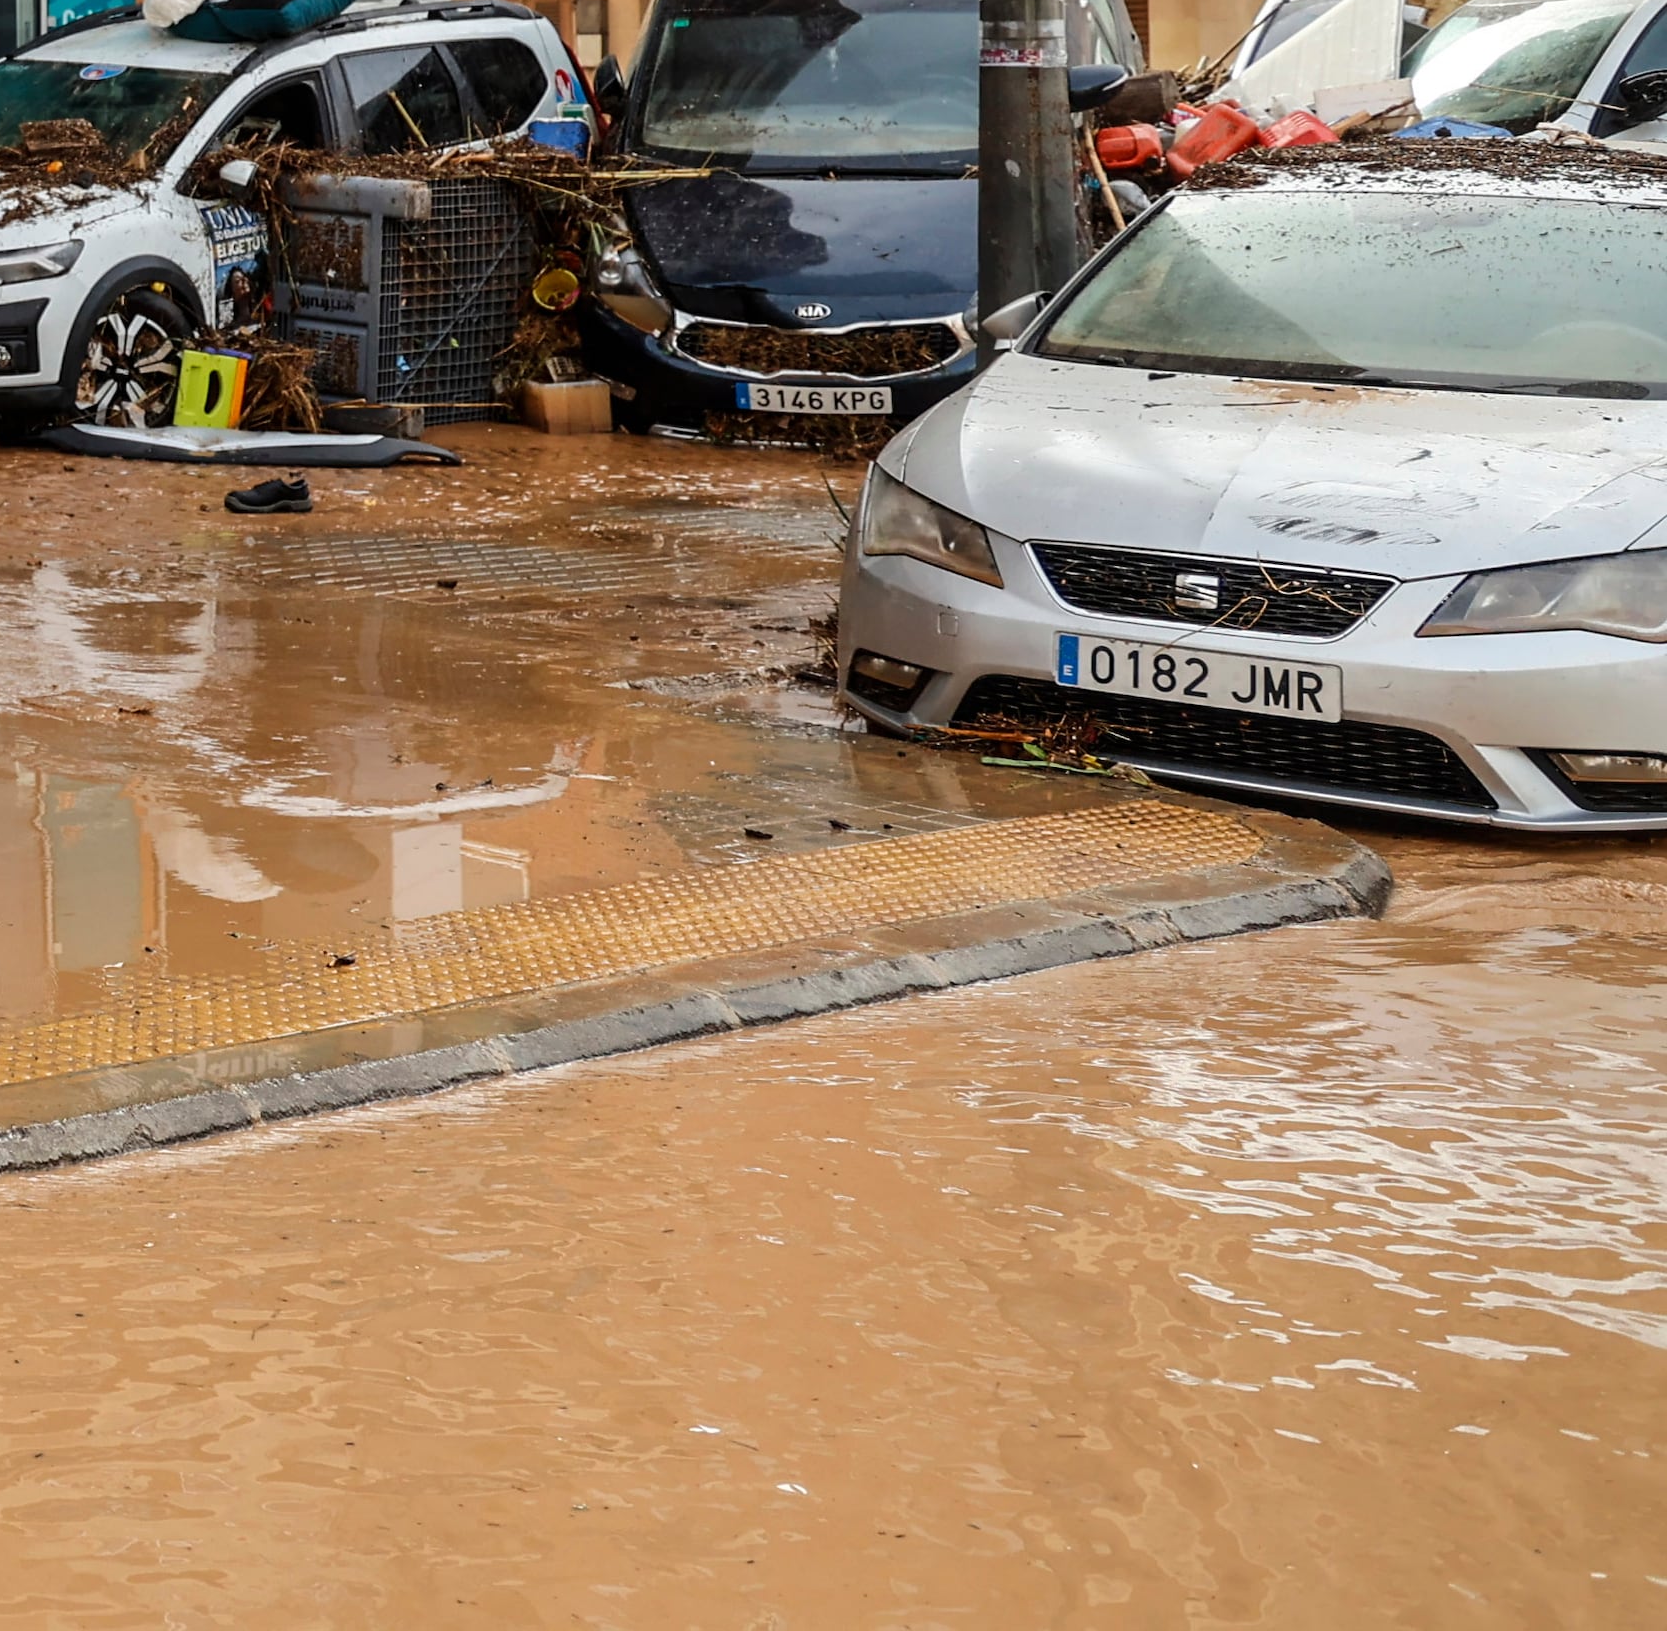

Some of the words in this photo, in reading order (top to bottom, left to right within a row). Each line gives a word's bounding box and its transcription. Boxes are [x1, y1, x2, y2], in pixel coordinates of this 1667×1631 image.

[796, 305, 825, 317] KIA
[756, 388, 823, 411] 3146
[834, 390, 885, 411] KPG
[1063, 664, 1073, 676] E
[1090, 644, 1209, 699] 0182
[1231, 664, 1324, 714] JMR
